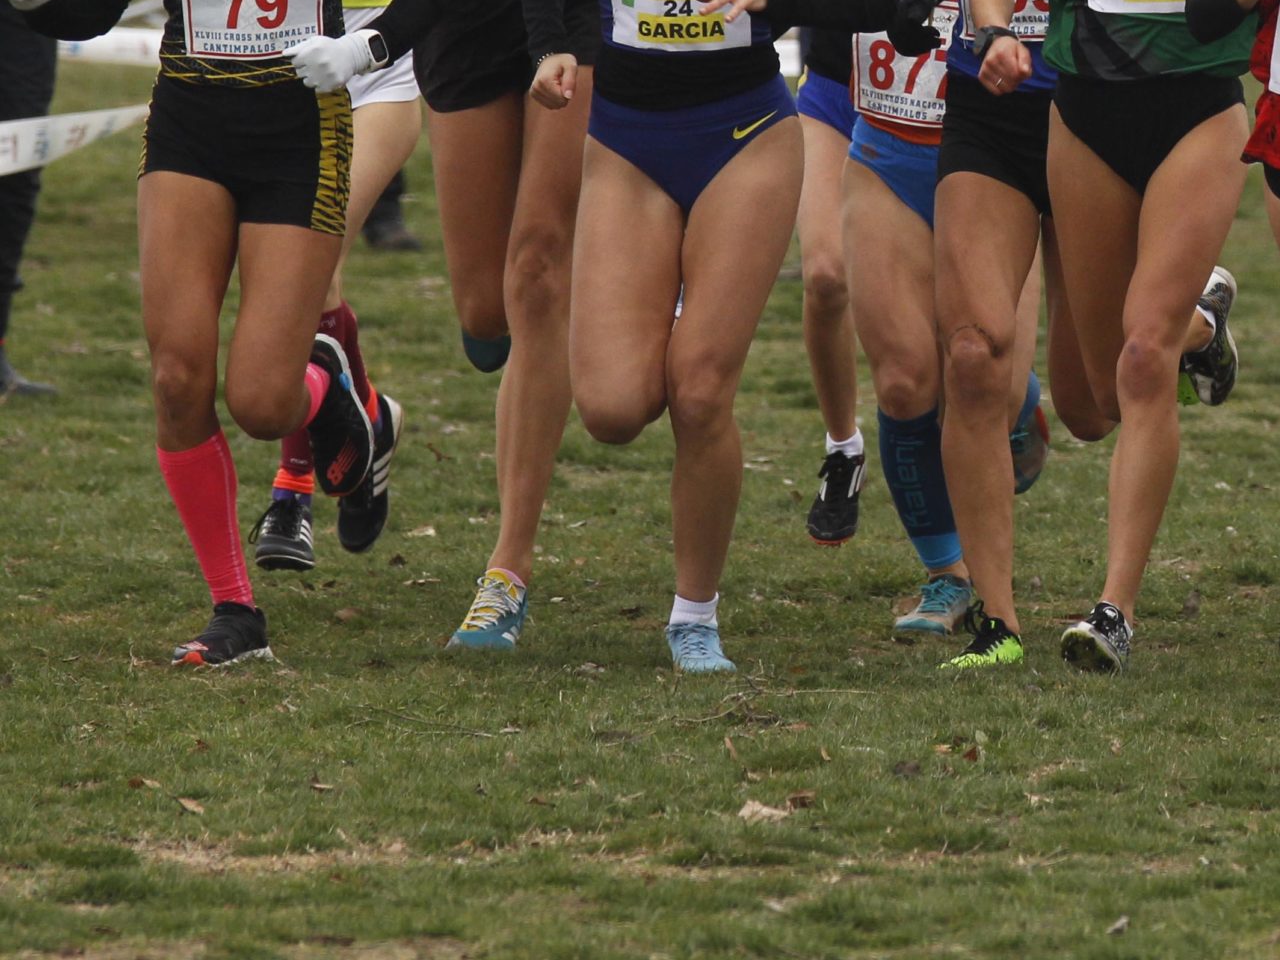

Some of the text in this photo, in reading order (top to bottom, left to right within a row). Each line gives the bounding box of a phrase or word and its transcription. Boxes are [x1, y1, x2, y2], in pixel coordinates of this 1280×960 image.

[663, 0, 694, 17] 24
[195, 26, 317, 42] XLVIII CROSS NACIONAL DE
[638, 20, 725, 39] GARCIA
[203, 42, 277, 54] CANTIMPALOS
[866, 100, 928, 121] CANTIMPALOS
